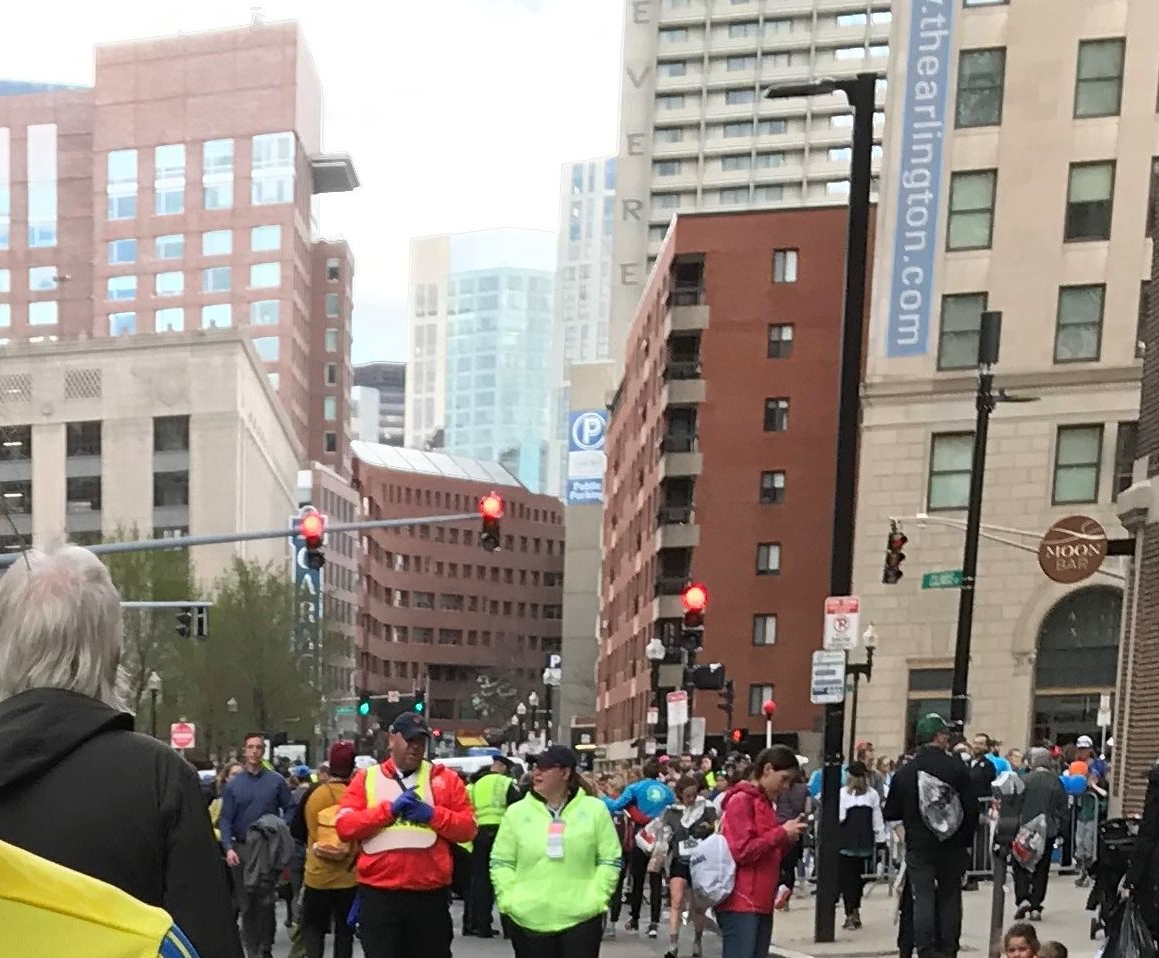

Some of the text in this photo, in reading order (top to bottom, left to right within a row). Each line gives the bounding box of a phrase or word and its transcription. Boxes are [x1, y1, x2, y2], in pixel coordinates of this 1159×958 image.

[897, 0, 949, 346] .thearlington.com
[1045, 543, 1100, 559] MOON
[1056, 558, 1089, 571] BAR
[550, 654, 561, 668] P
